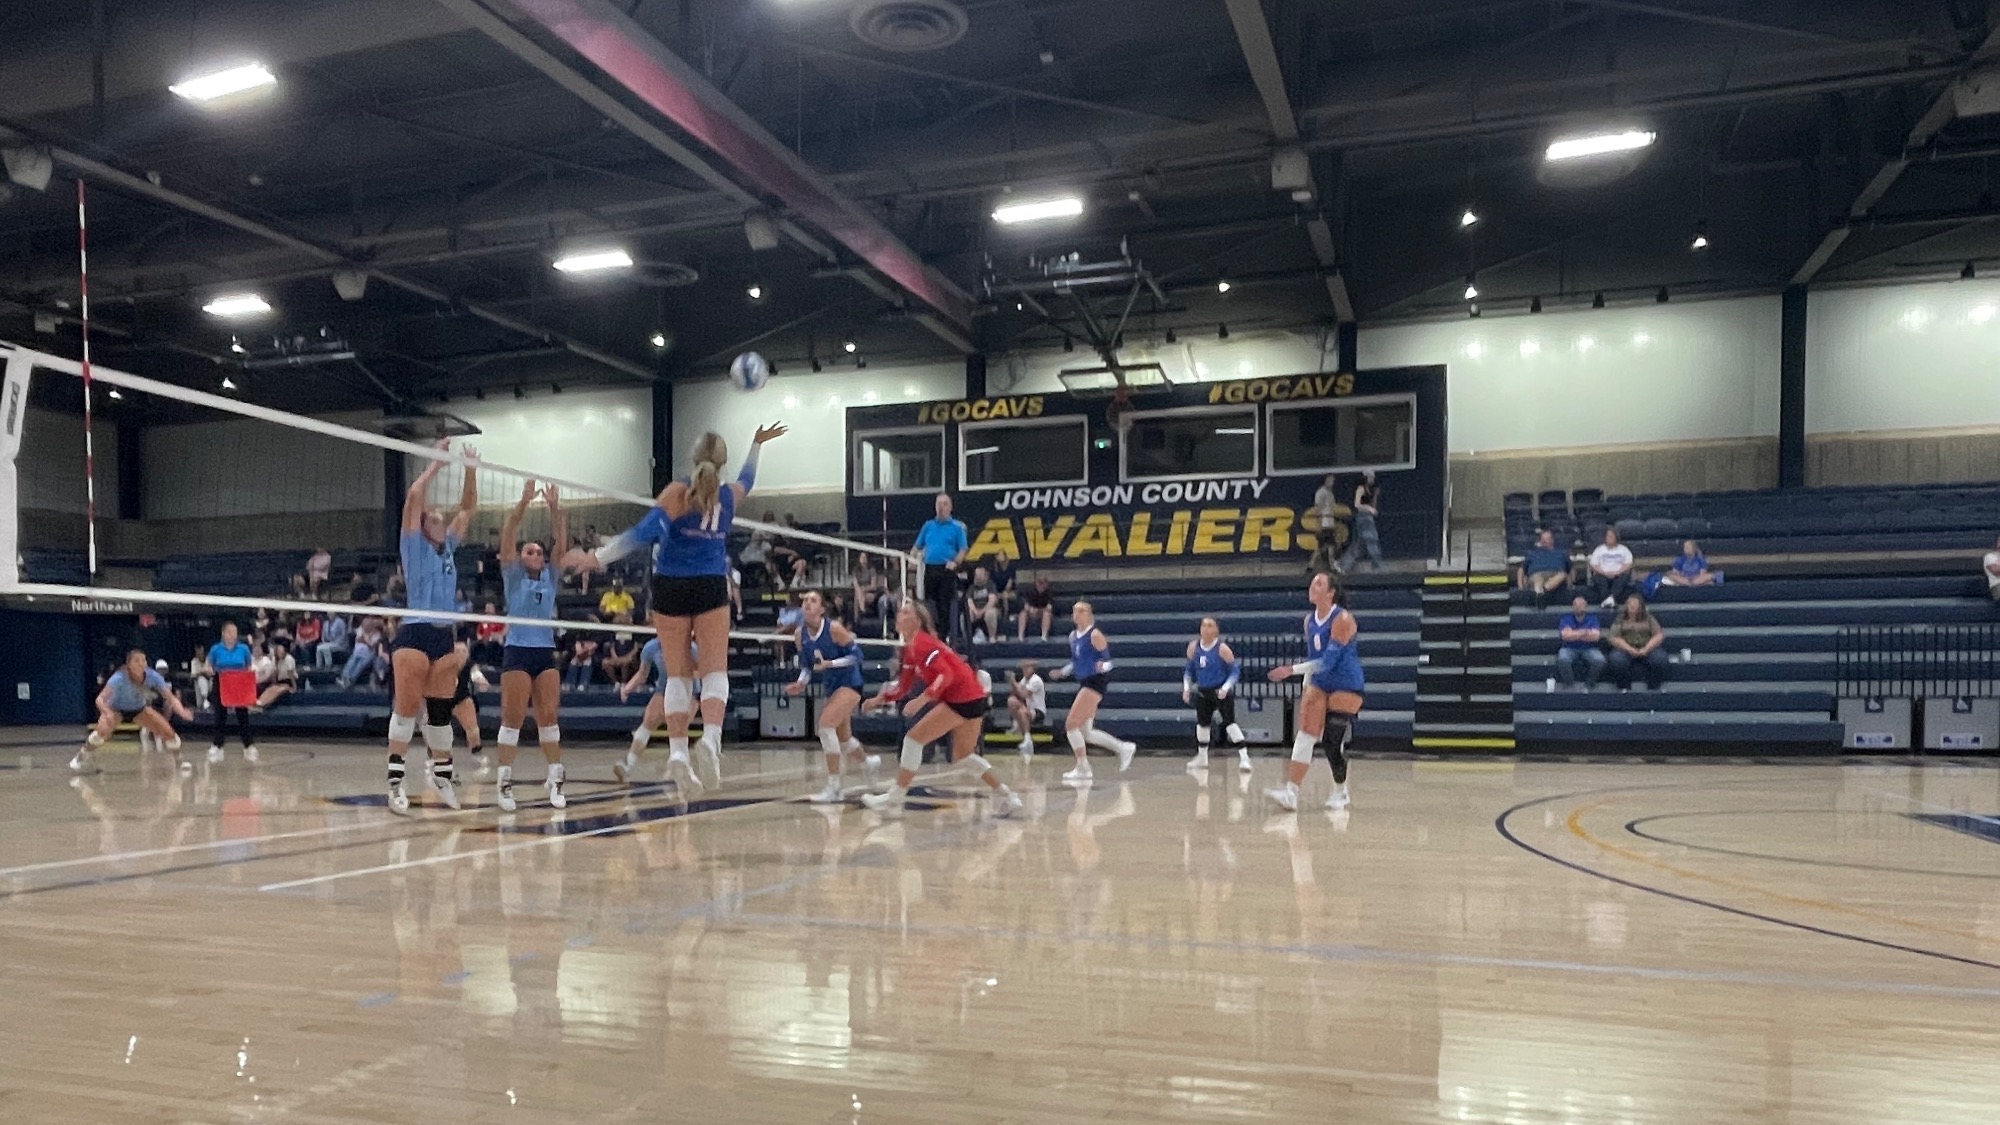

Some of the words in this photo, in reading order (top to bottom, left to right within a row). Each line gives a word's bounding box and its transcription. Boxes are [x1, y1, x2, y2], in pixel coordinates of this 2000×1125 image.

[994, 485, 1133, 510] JOHNSON
[1141, 478, 1269, 504] COUNTY
[965, 502, 1352, 562] AVALIERS
